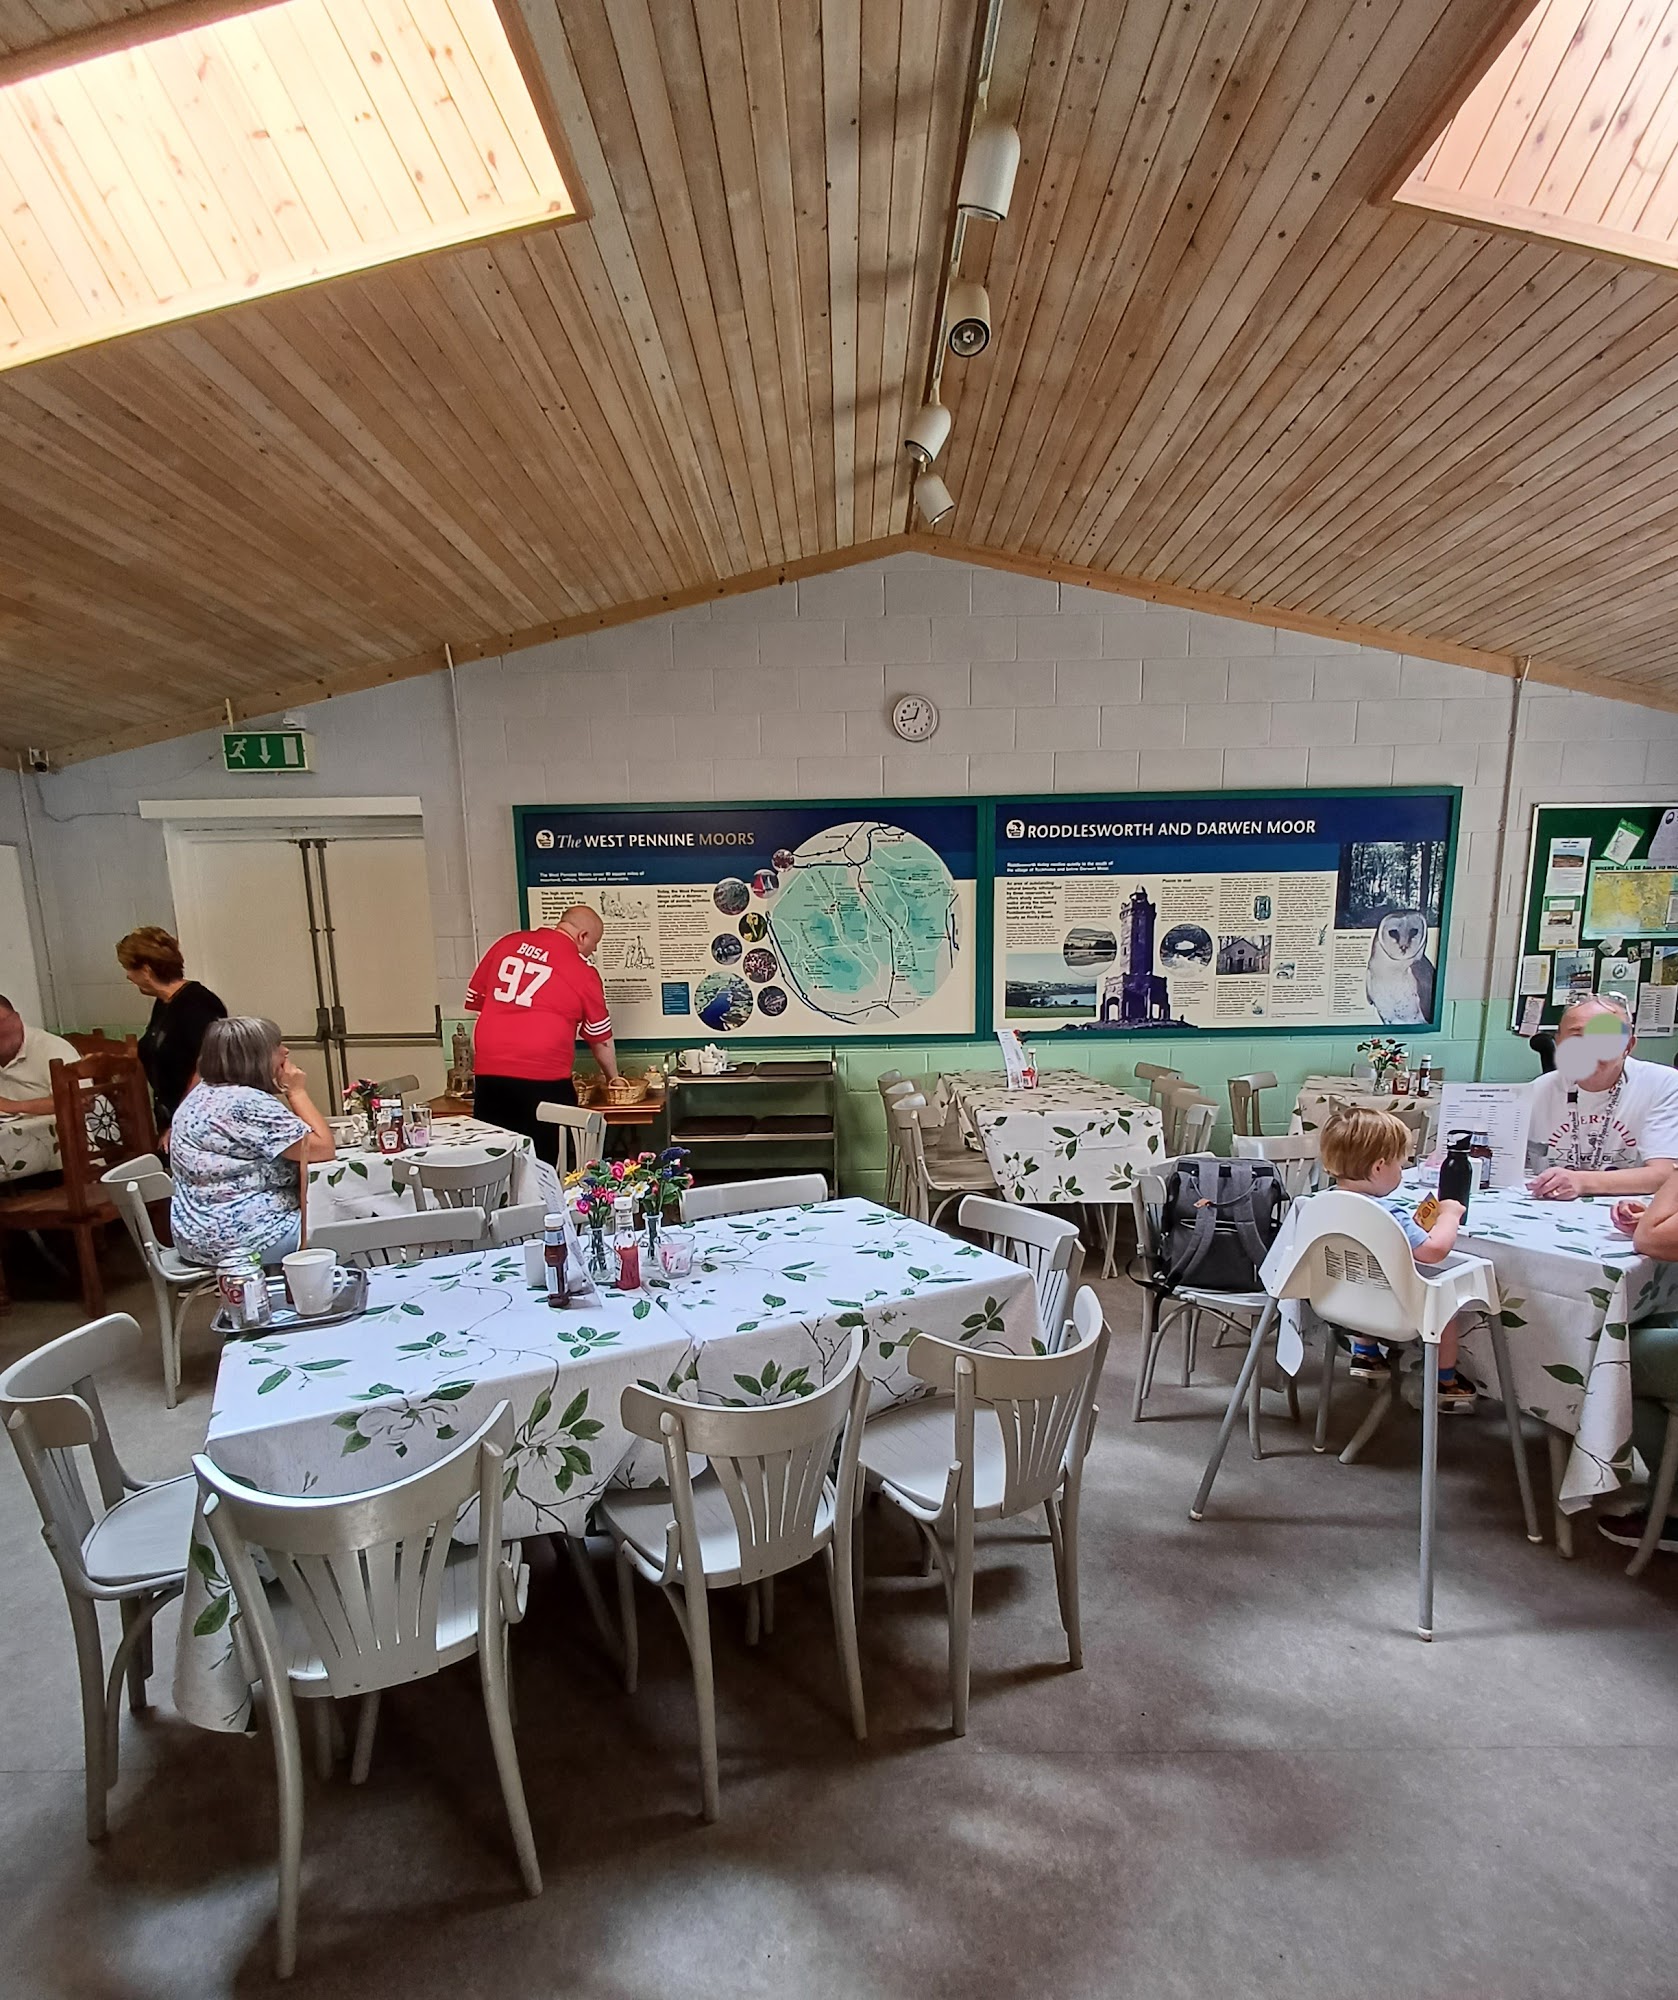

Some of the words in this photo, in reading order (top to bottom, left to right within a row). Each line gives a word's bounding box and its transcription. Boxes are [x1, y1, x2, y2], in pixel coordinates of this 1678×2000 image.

[1028, 823, 1154, 839] RODDLESWORTH
[1158, 822, 1191, 836] AND
[1196, 821, 1262, 835] DARWEN
[1267, 820, 1316, 834] MOOR
[558, 834, 582, 849] The
[584, 835, 624, 848] WEST
[629, 834, 695, 847] PENNINE
[700, 832, 755, 846] MOORS
[517, 942, 549, 962] BOSA
[494, 956, 553, 1007] 97
